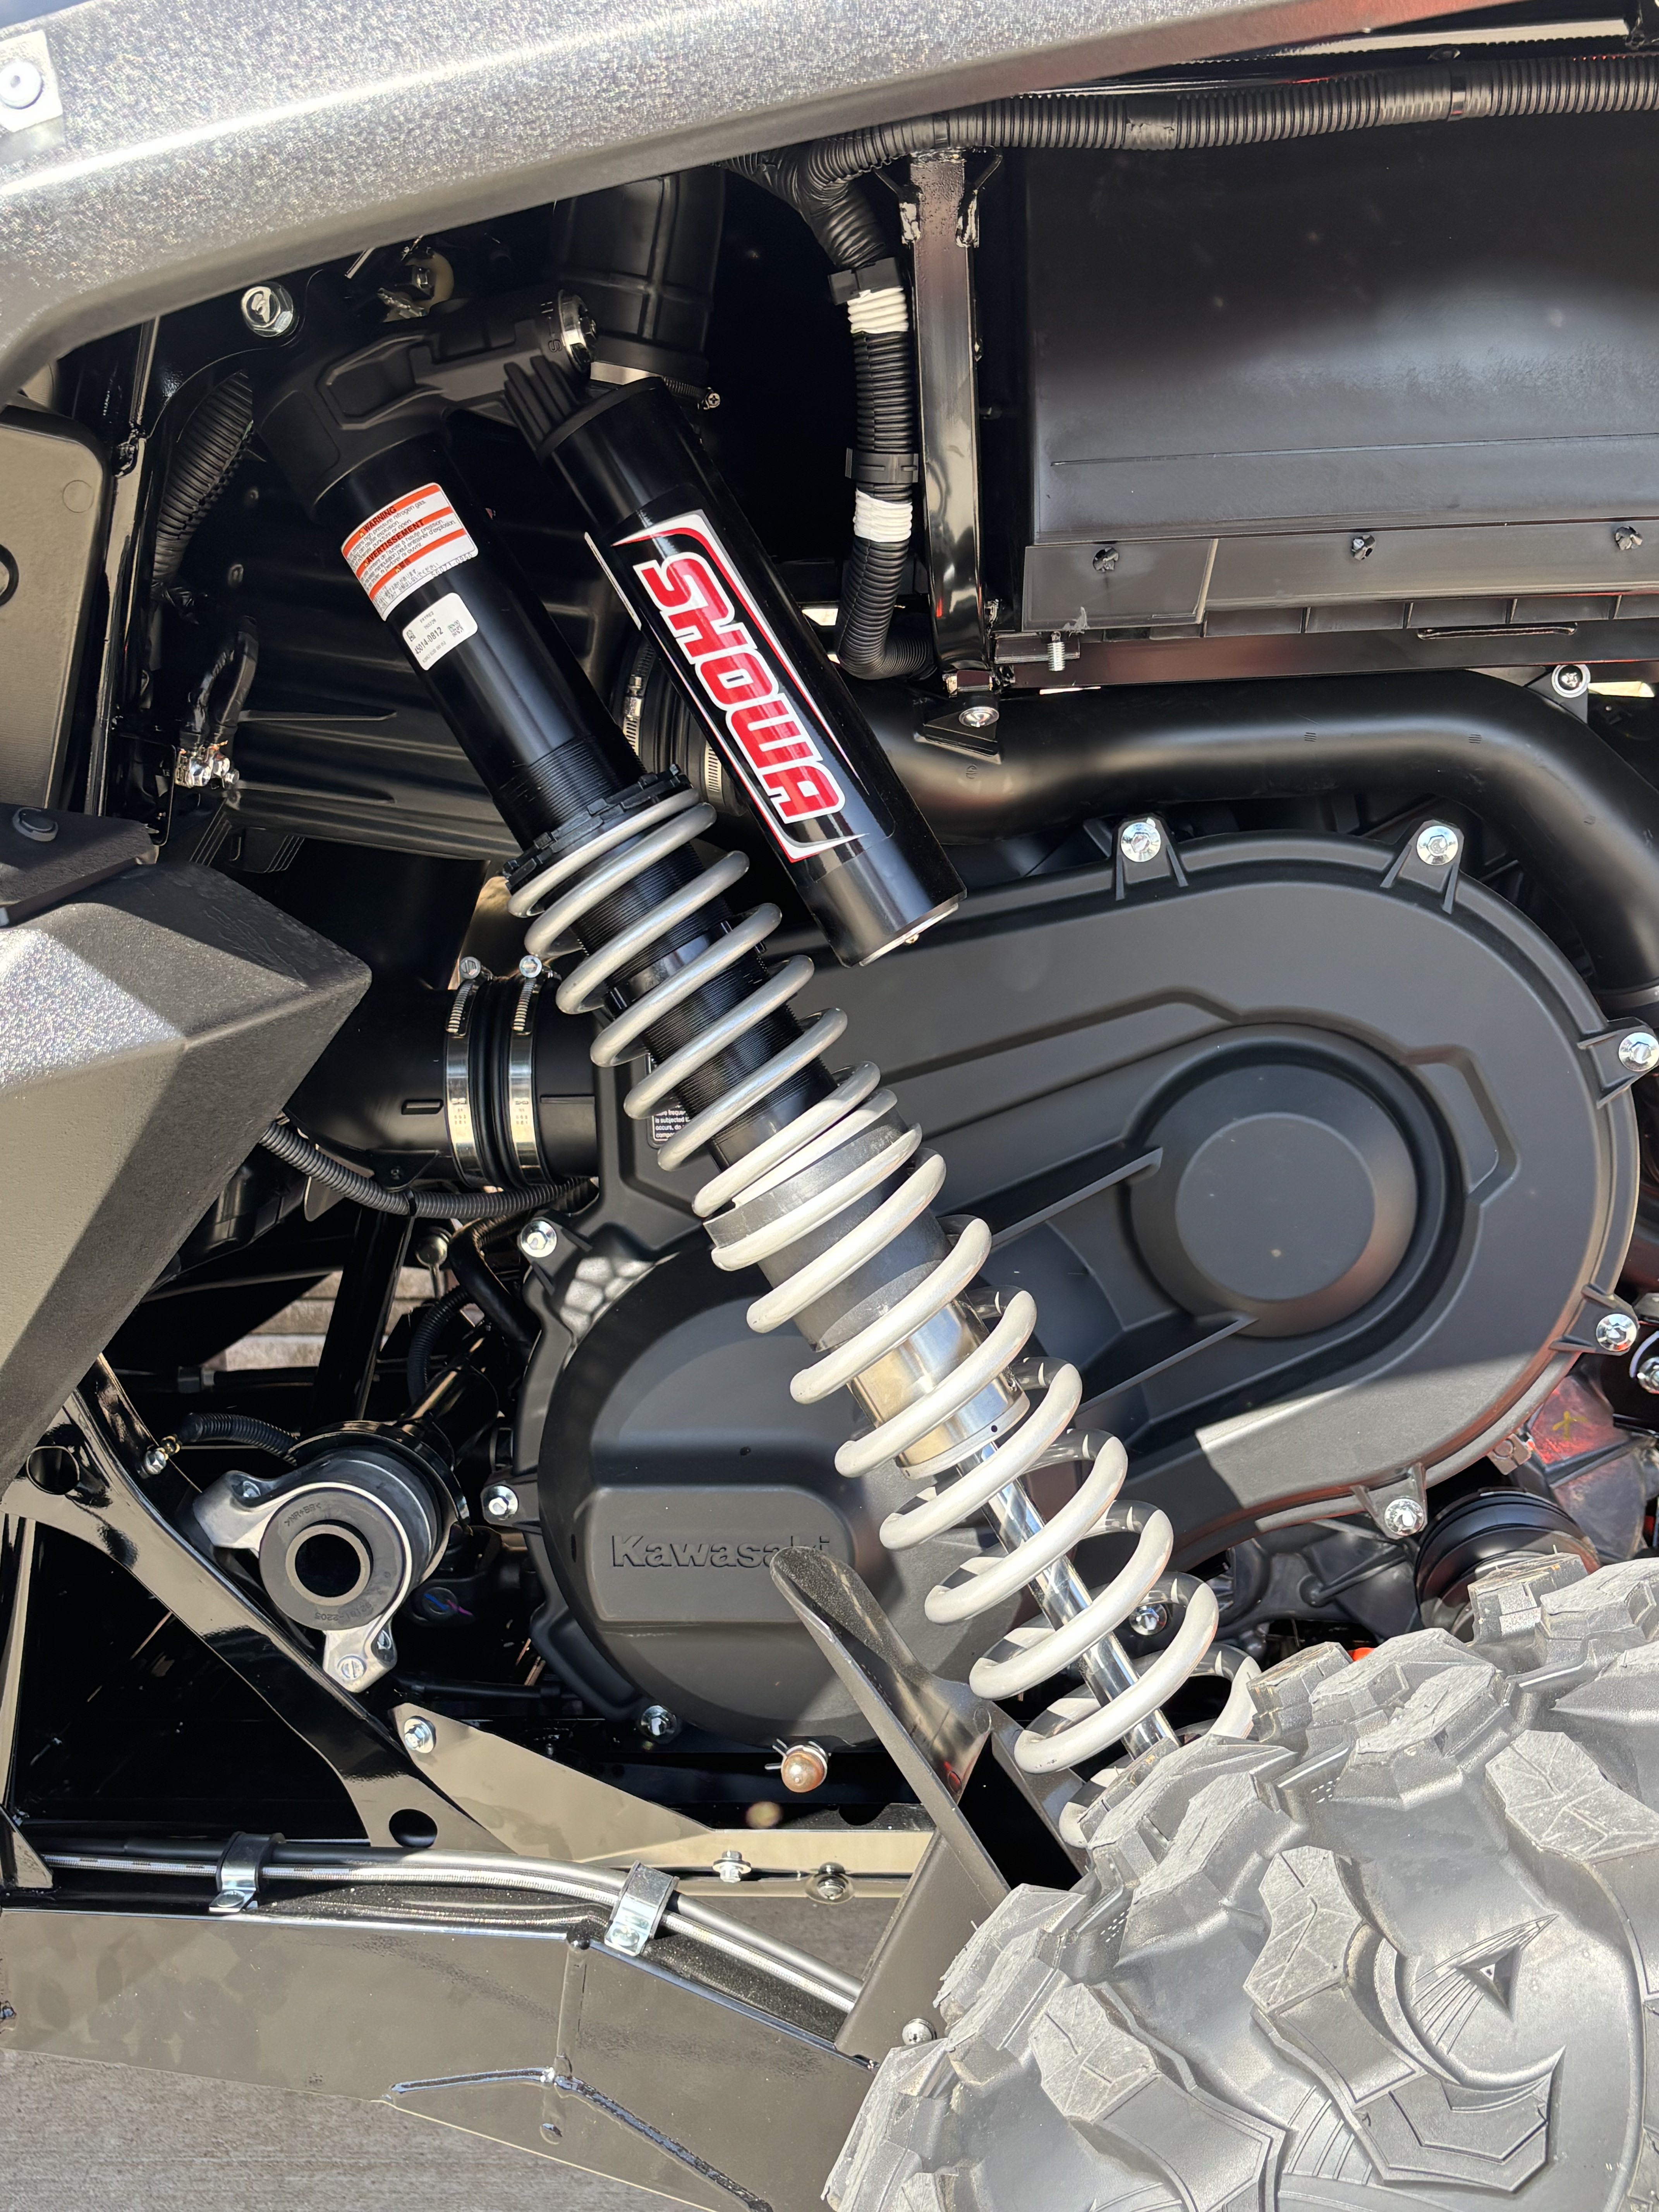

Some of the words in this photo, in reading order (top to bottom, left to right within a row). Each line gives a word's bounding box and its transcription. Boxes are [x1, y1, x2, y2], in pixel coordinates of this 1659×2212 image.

[362, 505, 397, 533] WARNING
[372, 517, 393, 535] pressure
[393, 504, 415, 520] nitrogen
[366, 519, 424, 564] AVERTISSEMENT
[373, 531, 392, 548] puncture
[414, 626, 444, 655] 45014-0812
[633, 551, 845, 824] SHOWA
